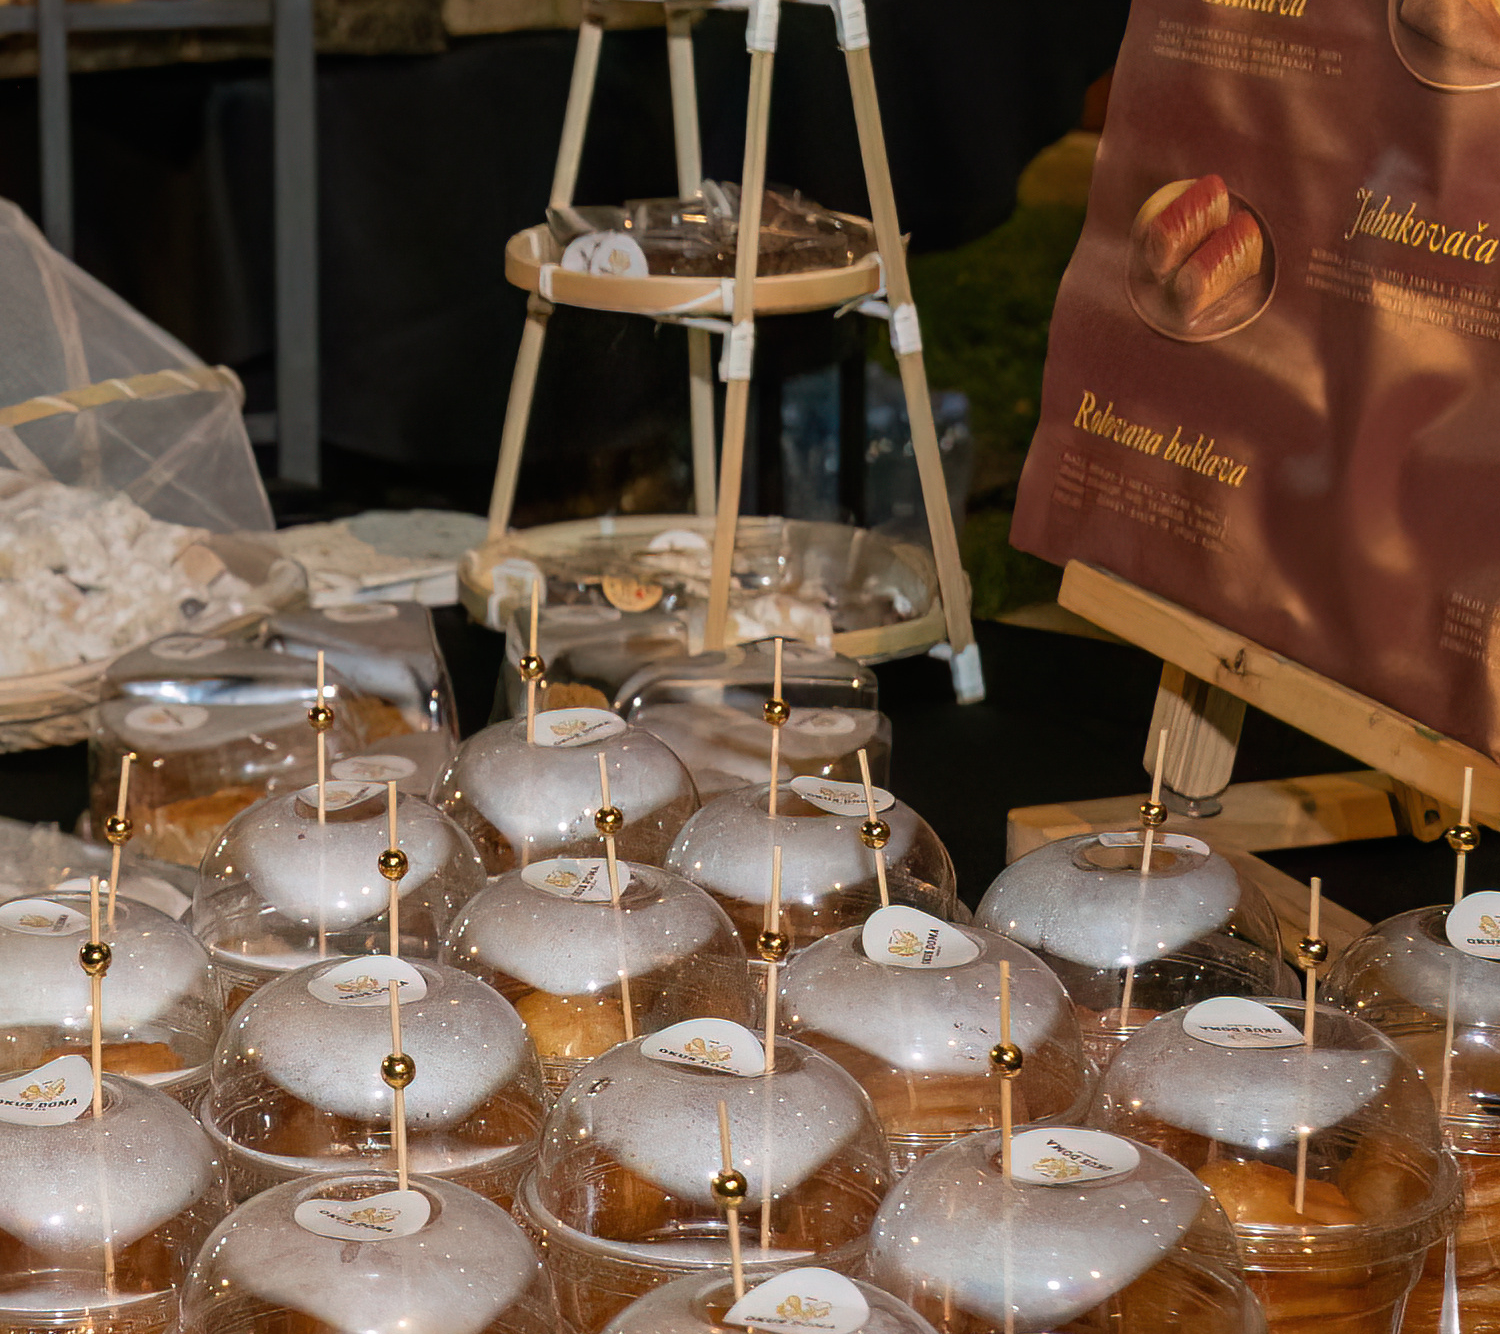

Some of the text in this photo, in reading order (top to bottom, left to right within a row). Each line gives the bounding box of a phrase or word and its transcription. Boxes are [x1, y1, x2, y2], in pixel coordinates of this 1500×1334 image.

[1345, 187, 1500, 265] Jabukovača
[1073, 390, 1249, 488] Rolovana baklava
[37, 1097, 79, 1109] DOMA
